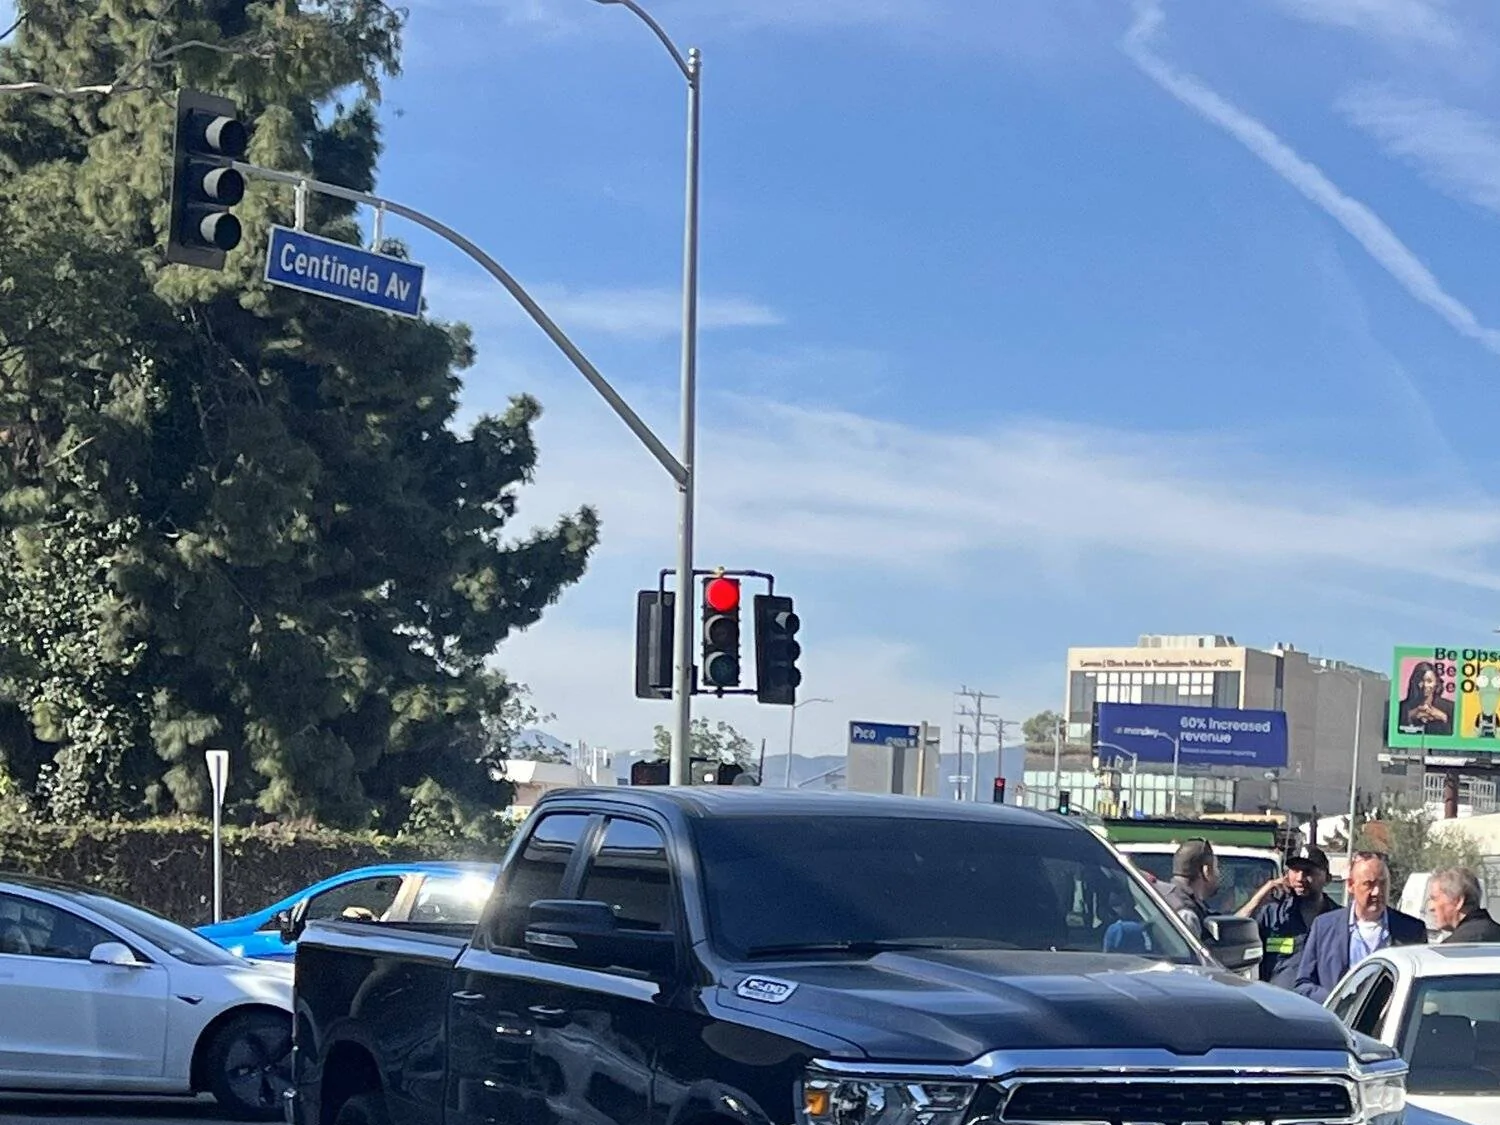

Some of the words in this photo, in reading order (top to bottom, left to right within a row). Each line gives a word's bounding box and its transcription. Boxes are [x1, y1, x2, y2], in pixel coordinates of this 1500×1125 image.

[280, 243, 379, 294] Centinela
[385, 272, 411, 301] Av
[1434, 648, 1457, 661] Be
[1180, 716, 1207, 731] 60%
[1208, 719, 1271, 733] increased
[1180, 730, 1232, 744] revenue
